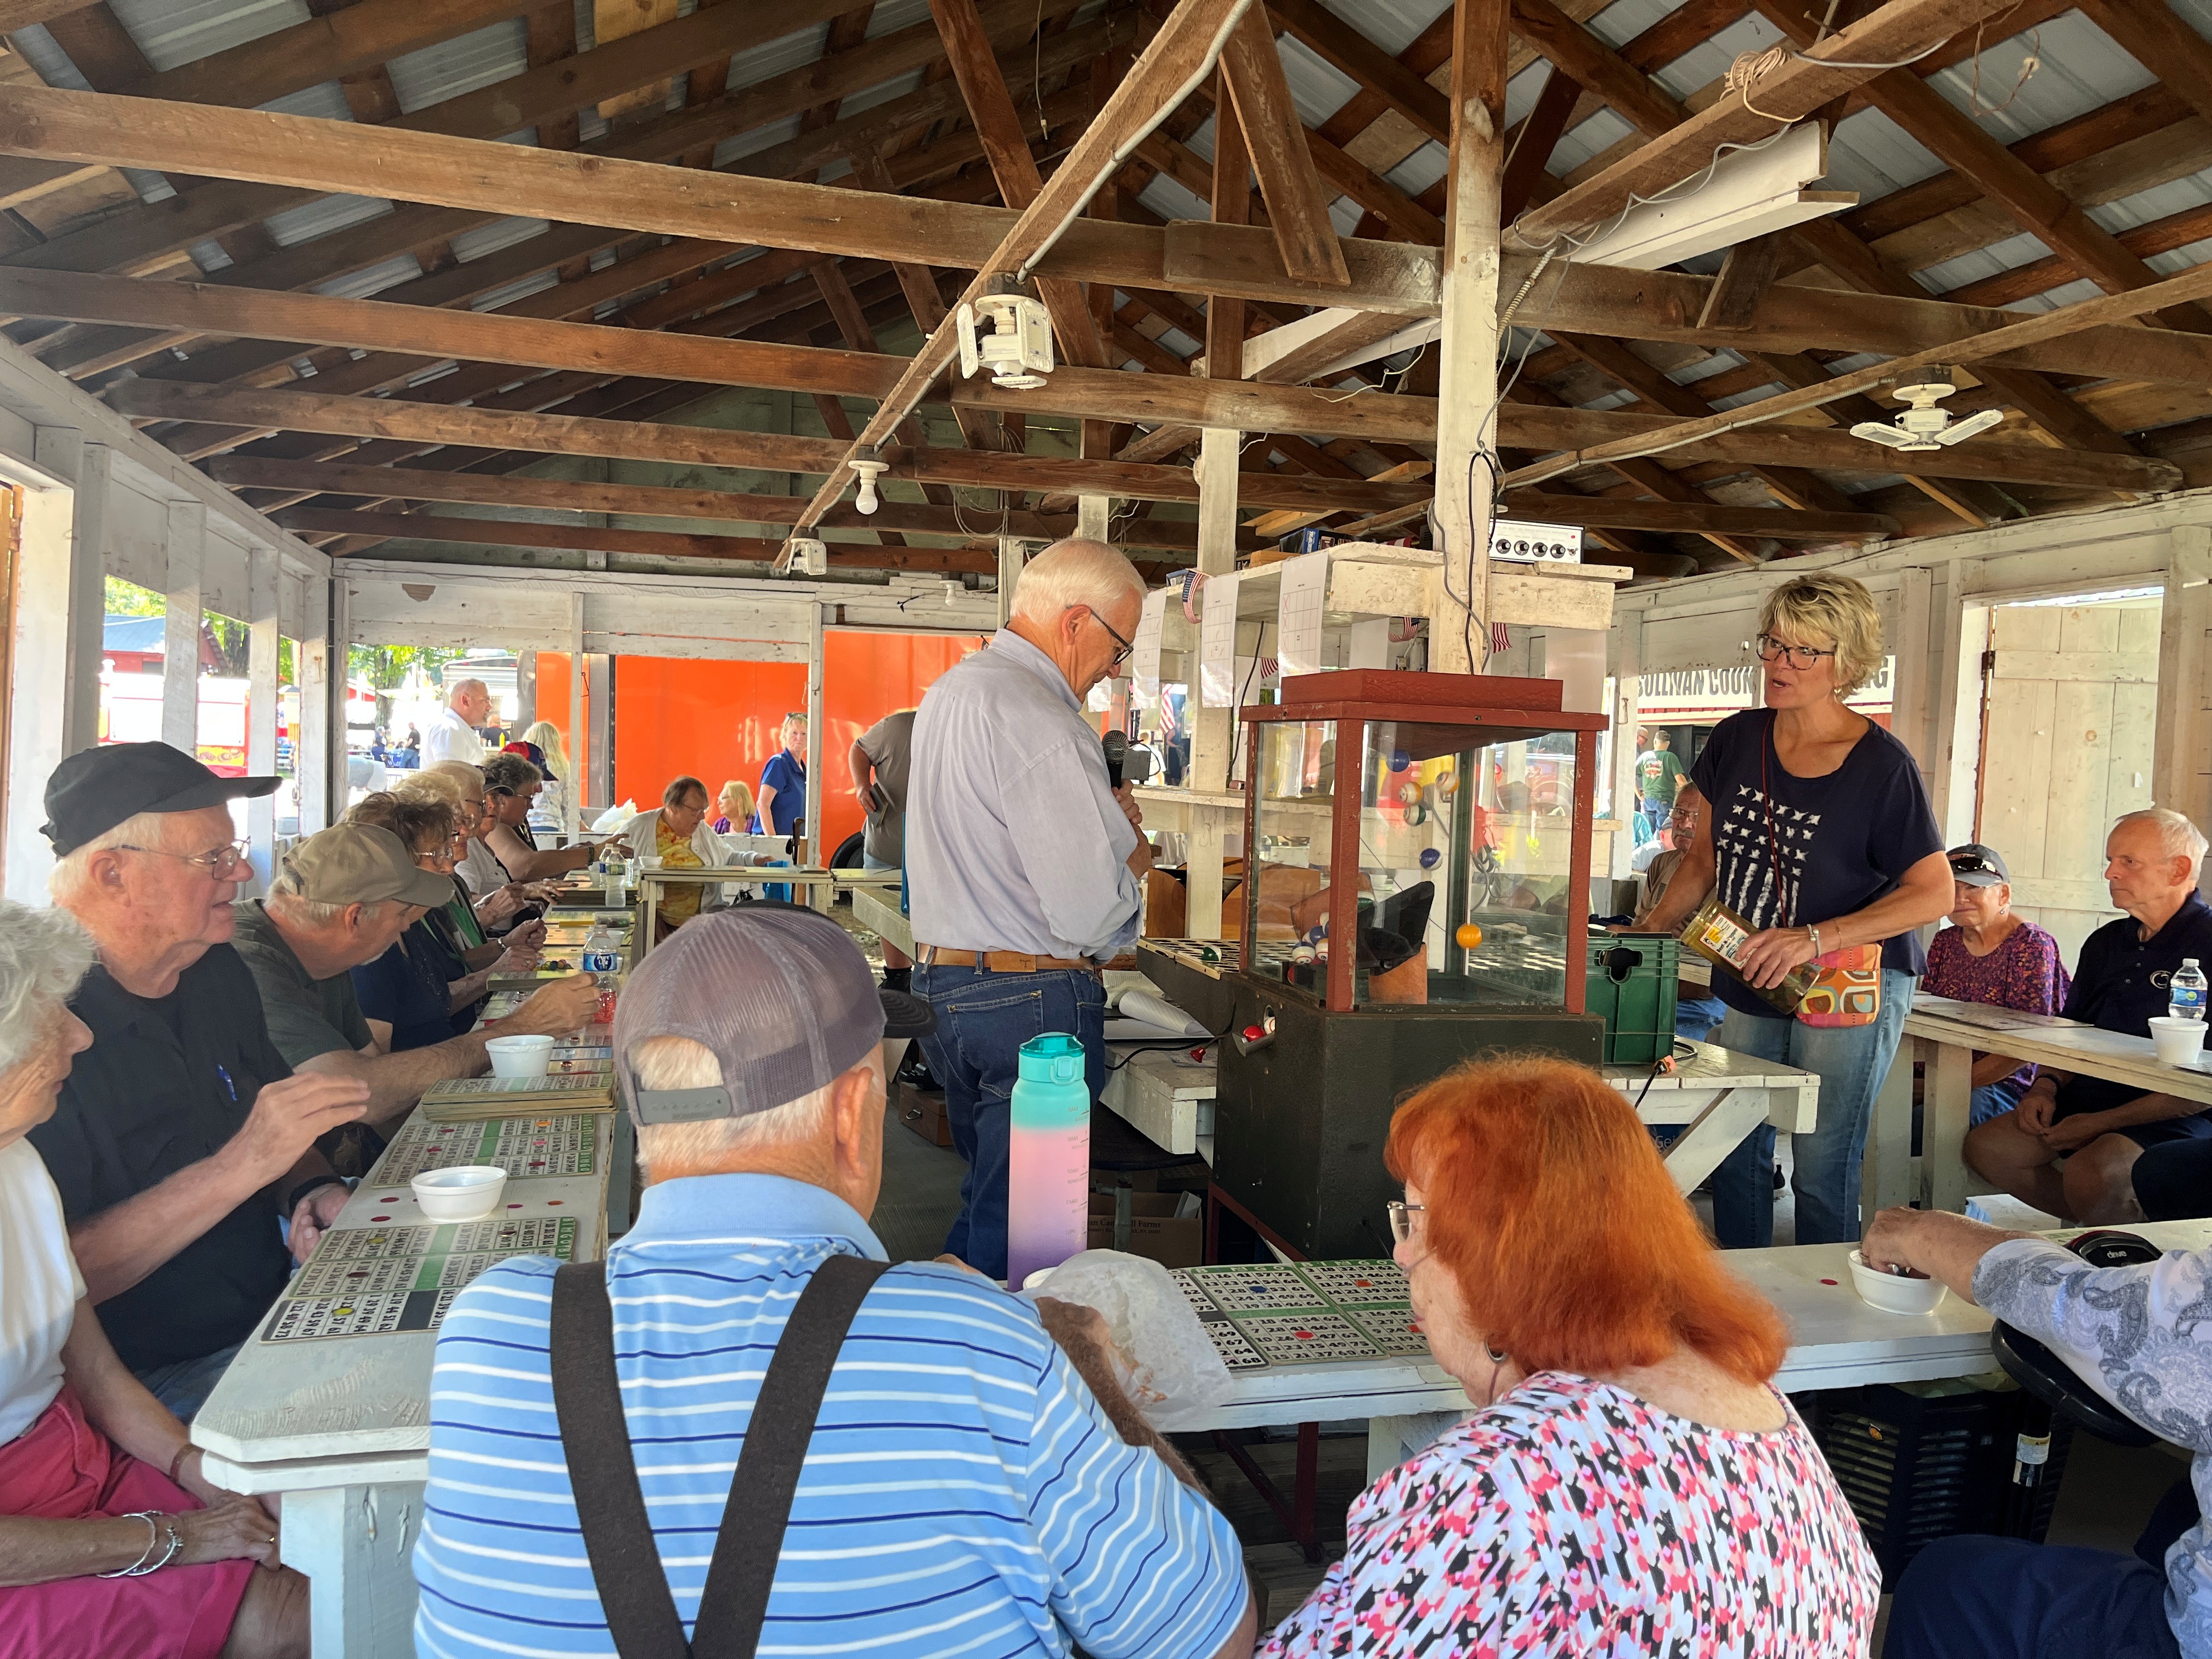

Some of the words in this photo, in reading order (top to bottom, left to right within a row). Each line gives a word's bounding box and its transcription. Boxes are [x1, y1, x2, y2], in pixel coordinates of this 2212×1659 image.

[1638, 670, 1705, 697] SULLIVAN
[1709, 668, 1753, 696] COUN
[560, 1217, 574, 1244] BINGO
[1101, 1219, 1136, 1227] Camll
[1138, 1220, 1161, 1228] Farms
